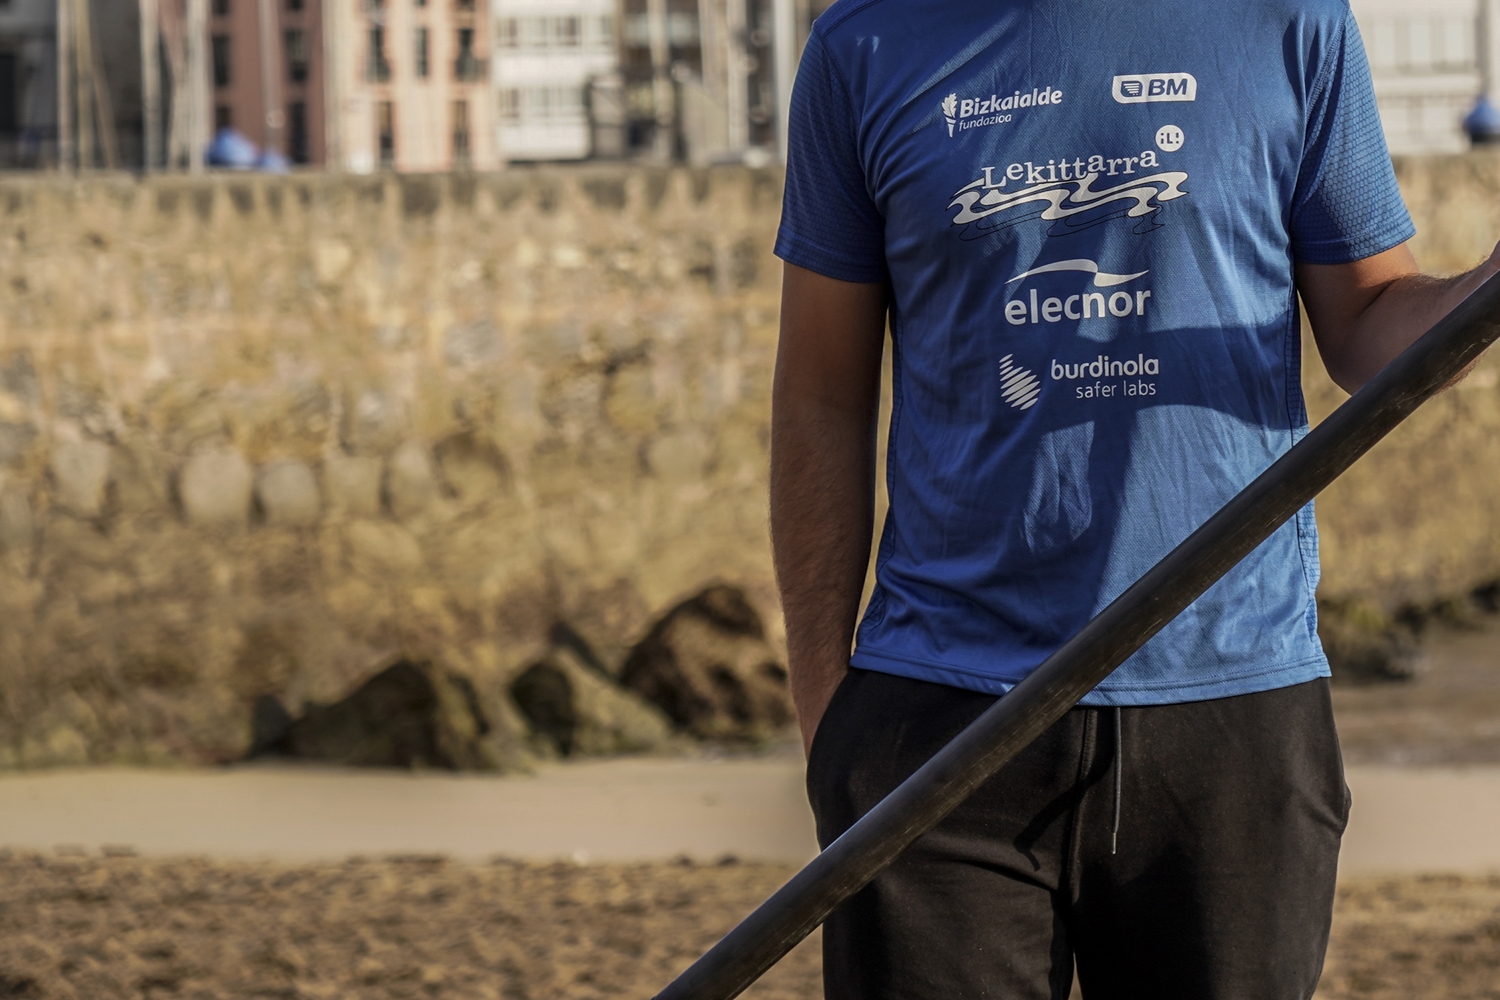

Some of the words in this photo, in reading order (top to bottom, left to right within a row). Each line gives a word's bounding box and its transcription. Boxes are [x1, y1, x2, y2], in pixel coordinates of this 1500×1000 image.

[1147, 78, 1189, 96] BM
[960, 86, 1063, 119] Bizkaialde
[958, 113, 1012, 132] fundazioa
[981, 150, 1160, 190] Lekittarra
[1004, 288, 1151, 326] elecnor
[1050, 353, 1159, 381] burdinola
[1076, 381, 1117, 399] safer
[1123, 379, 1157, 397] labs
